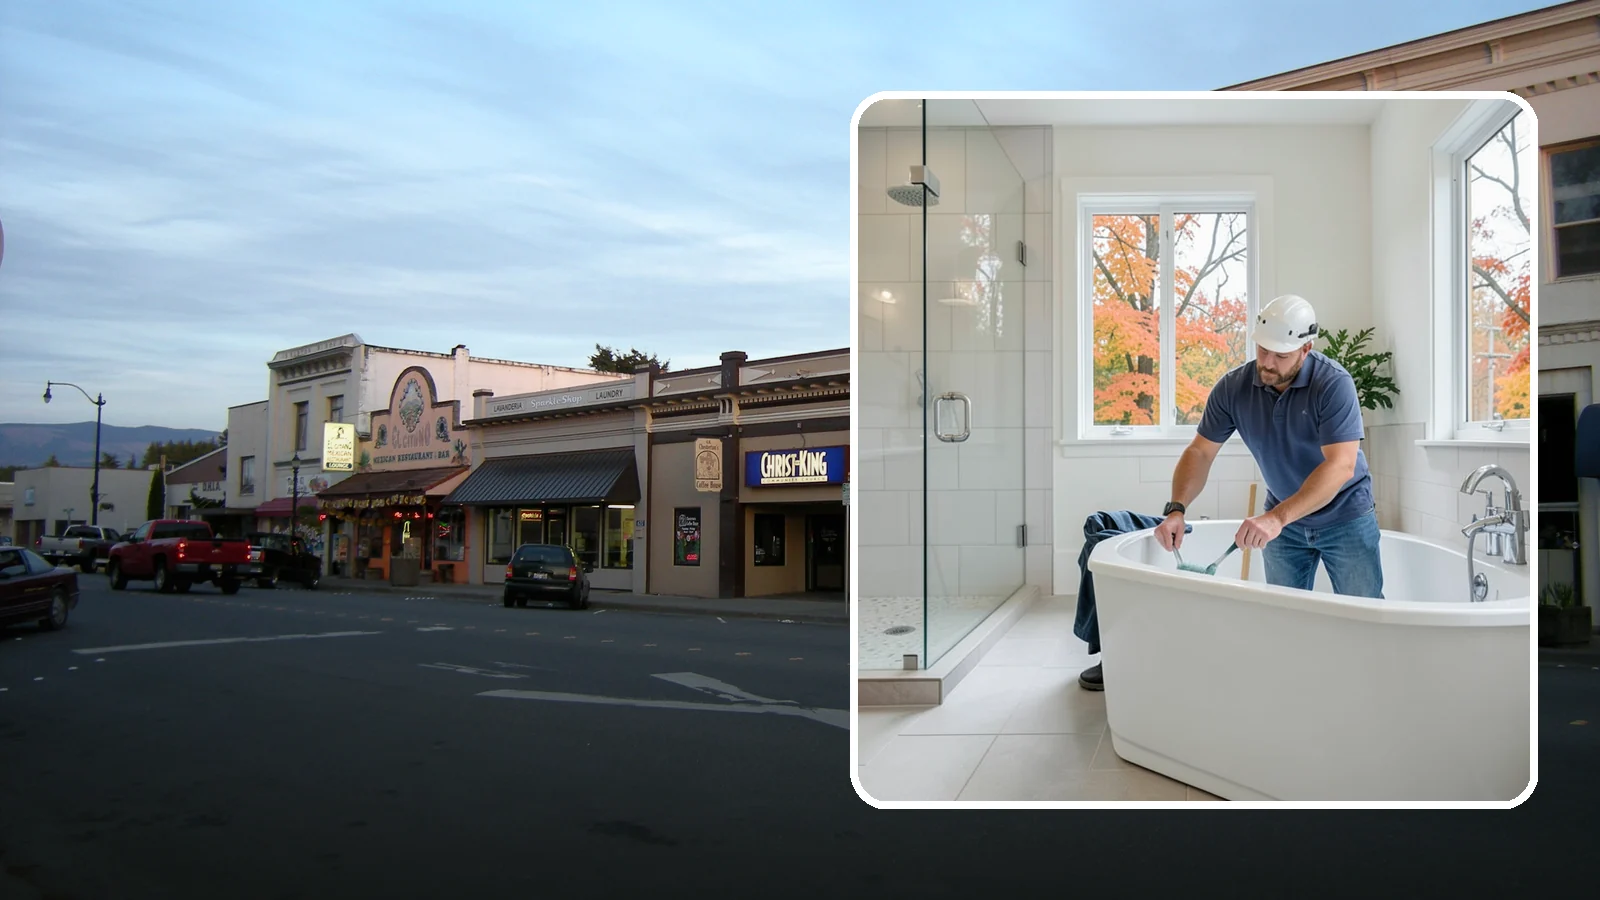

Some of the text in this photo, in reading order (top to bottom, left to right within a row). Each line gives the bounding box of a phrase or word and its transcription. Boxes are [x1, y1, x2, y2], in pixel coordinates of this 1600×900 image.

[531, 394, 583, 409] Sparkle Shop
[596, 389, 624, 400] LAUNDRY
[493, 402, 522, 412] LAVANDERIA
[373, 449, 450, 464] MEXICAN RESTAURANT BAR
[761, 449, 827, 478] CHRIST KING
